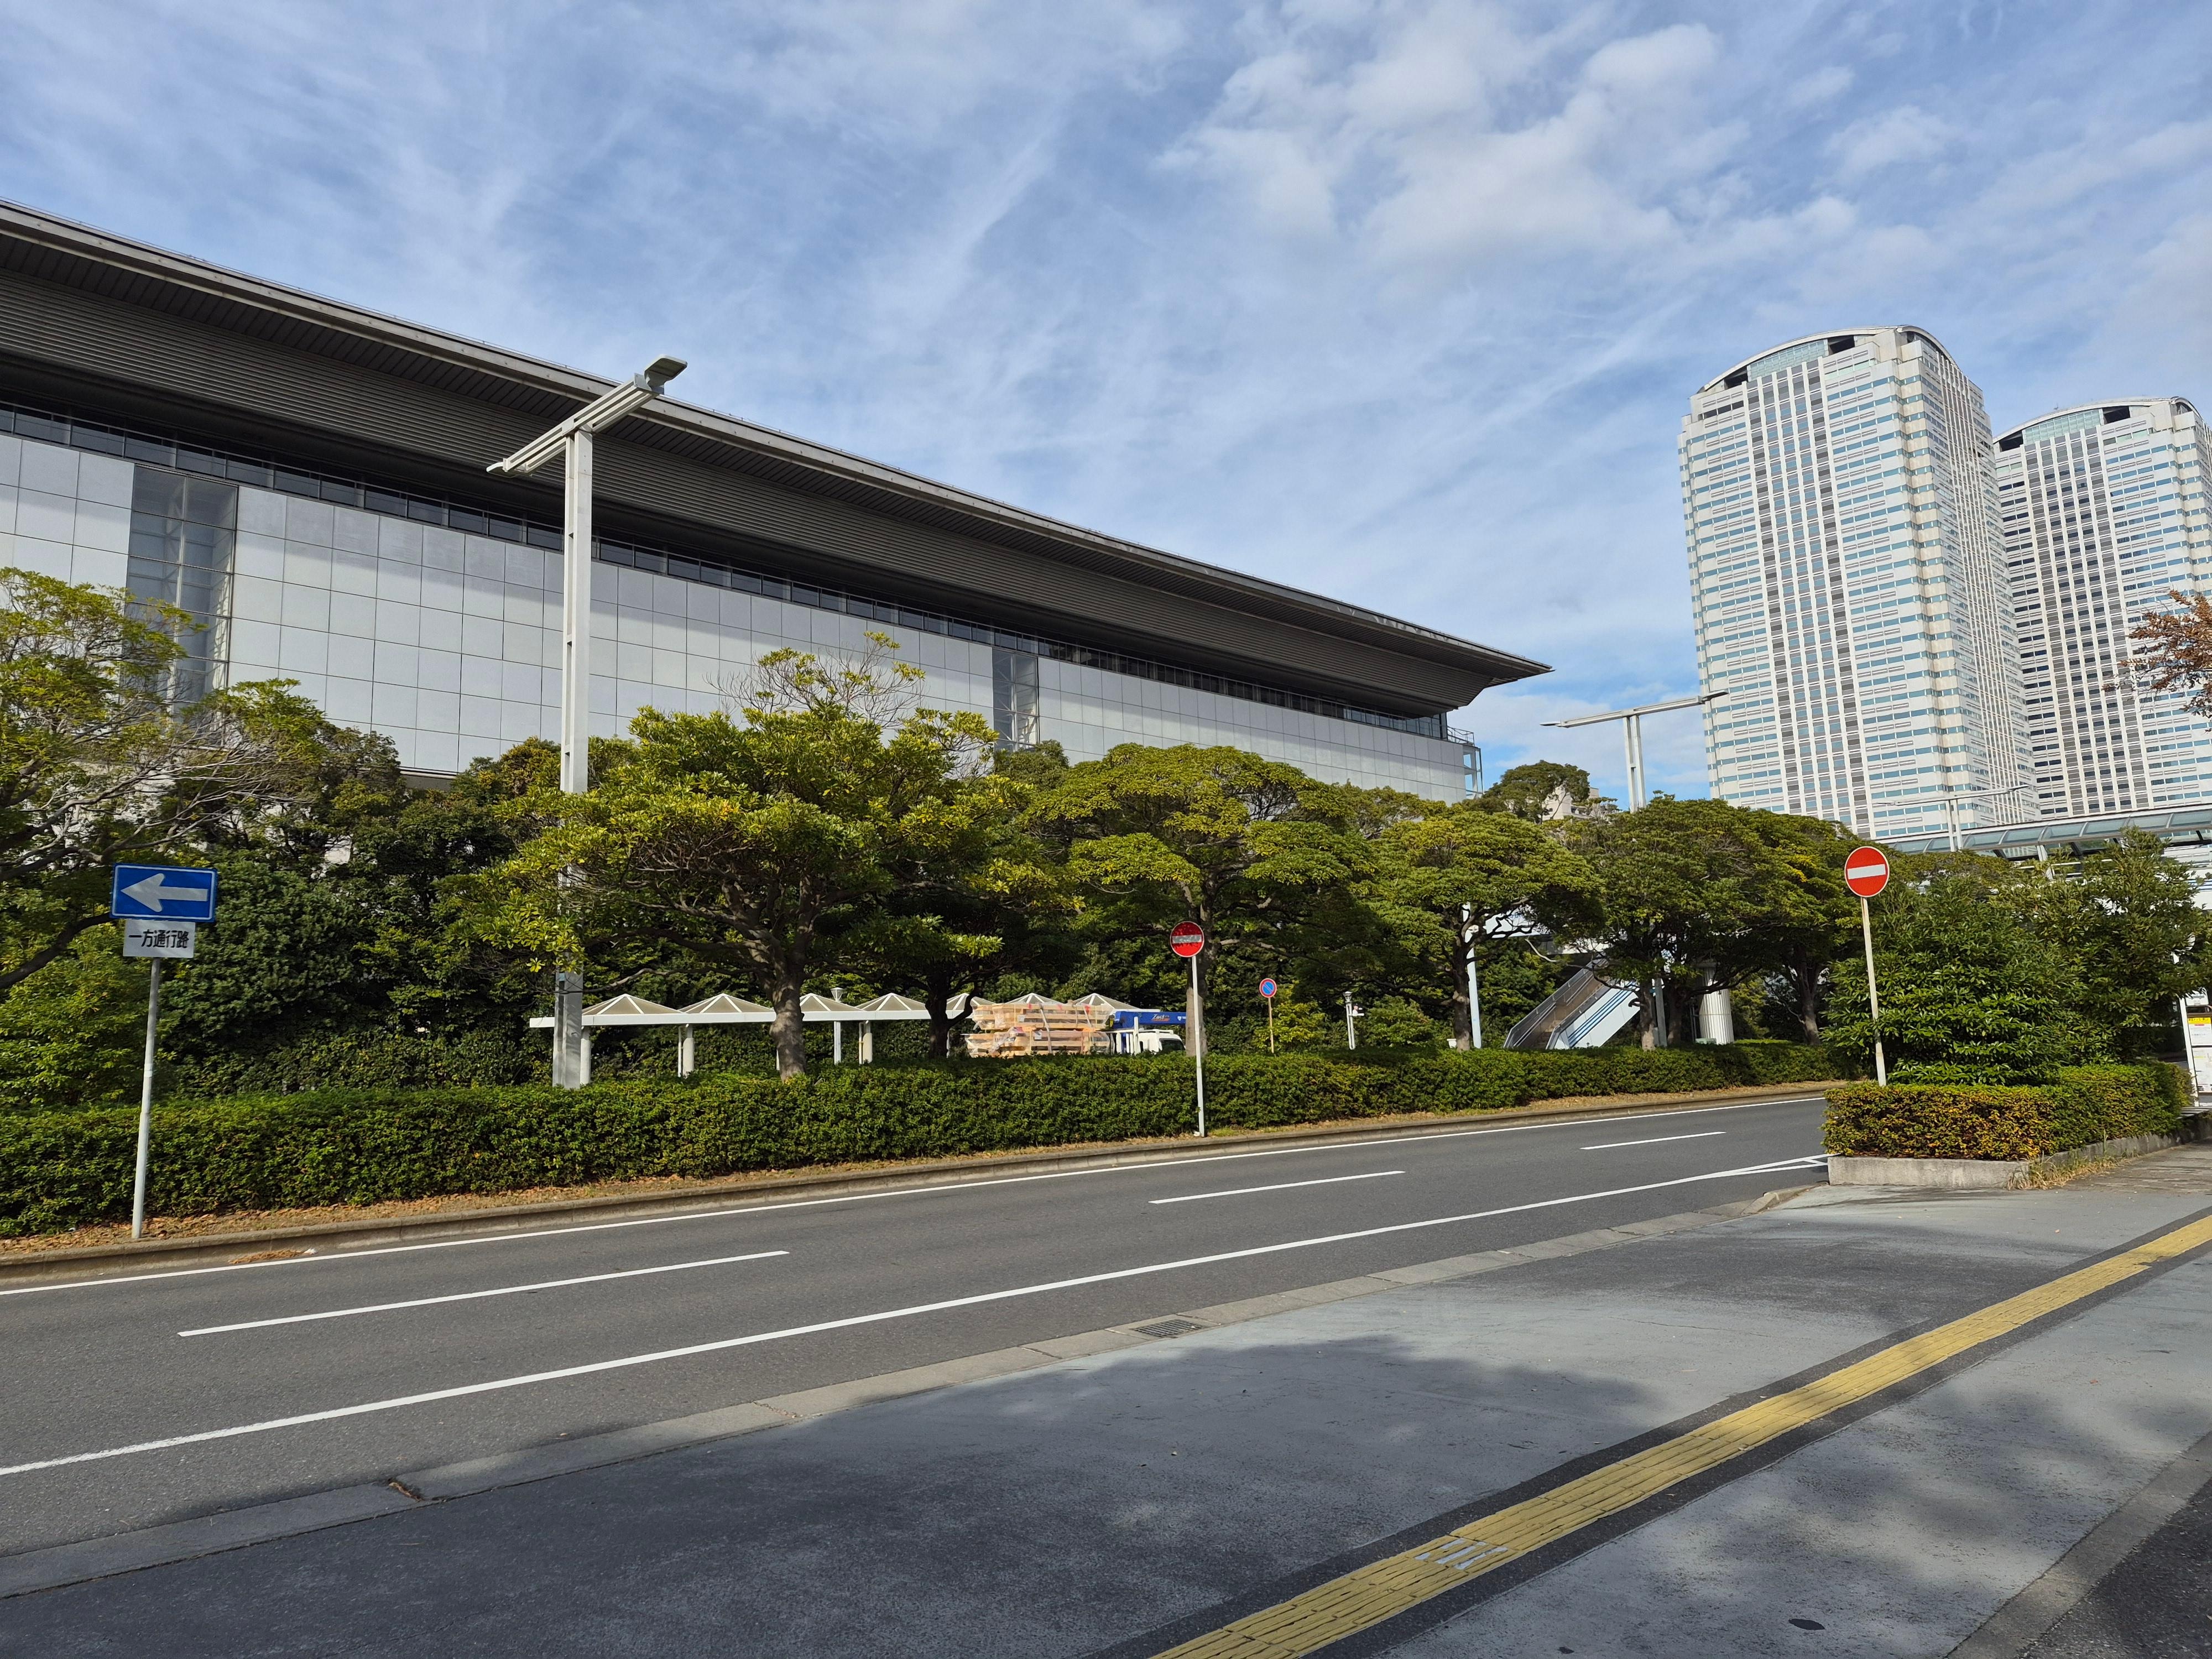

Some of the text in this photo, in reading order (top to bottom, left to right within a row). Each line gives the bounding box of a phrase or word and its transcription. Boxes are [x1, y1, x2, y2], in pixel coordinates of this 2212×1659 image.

[128, 929, 189, 948] 一方通行路
